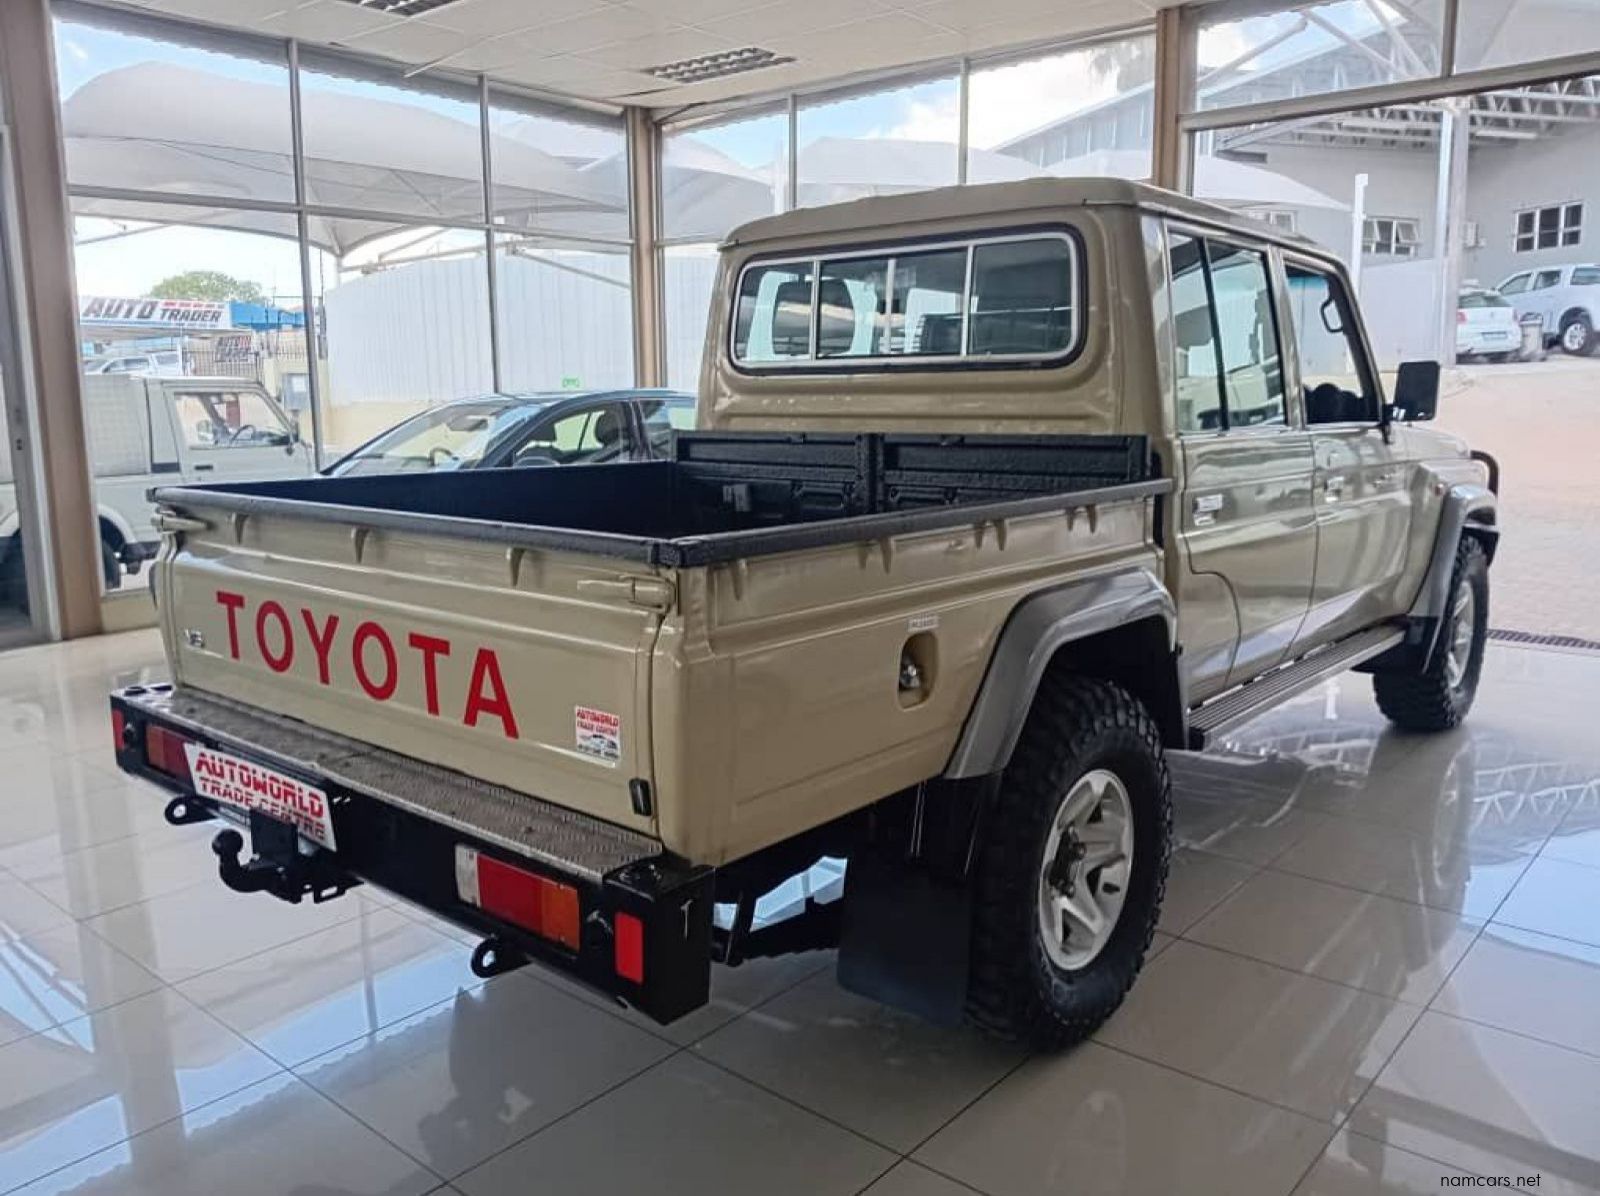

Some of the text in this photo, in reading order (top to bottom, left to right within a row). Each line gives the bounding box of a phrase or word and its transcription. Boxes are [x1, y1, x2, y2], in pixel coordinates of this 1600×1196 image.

[82, 297, 222, 322] AUTO TRADER
[217, 591, 519, 739] TOYOTA
[196, 753, 324, 818] AUTOWORLD
[200, 777, 326, 841] TRADE CENTRE
